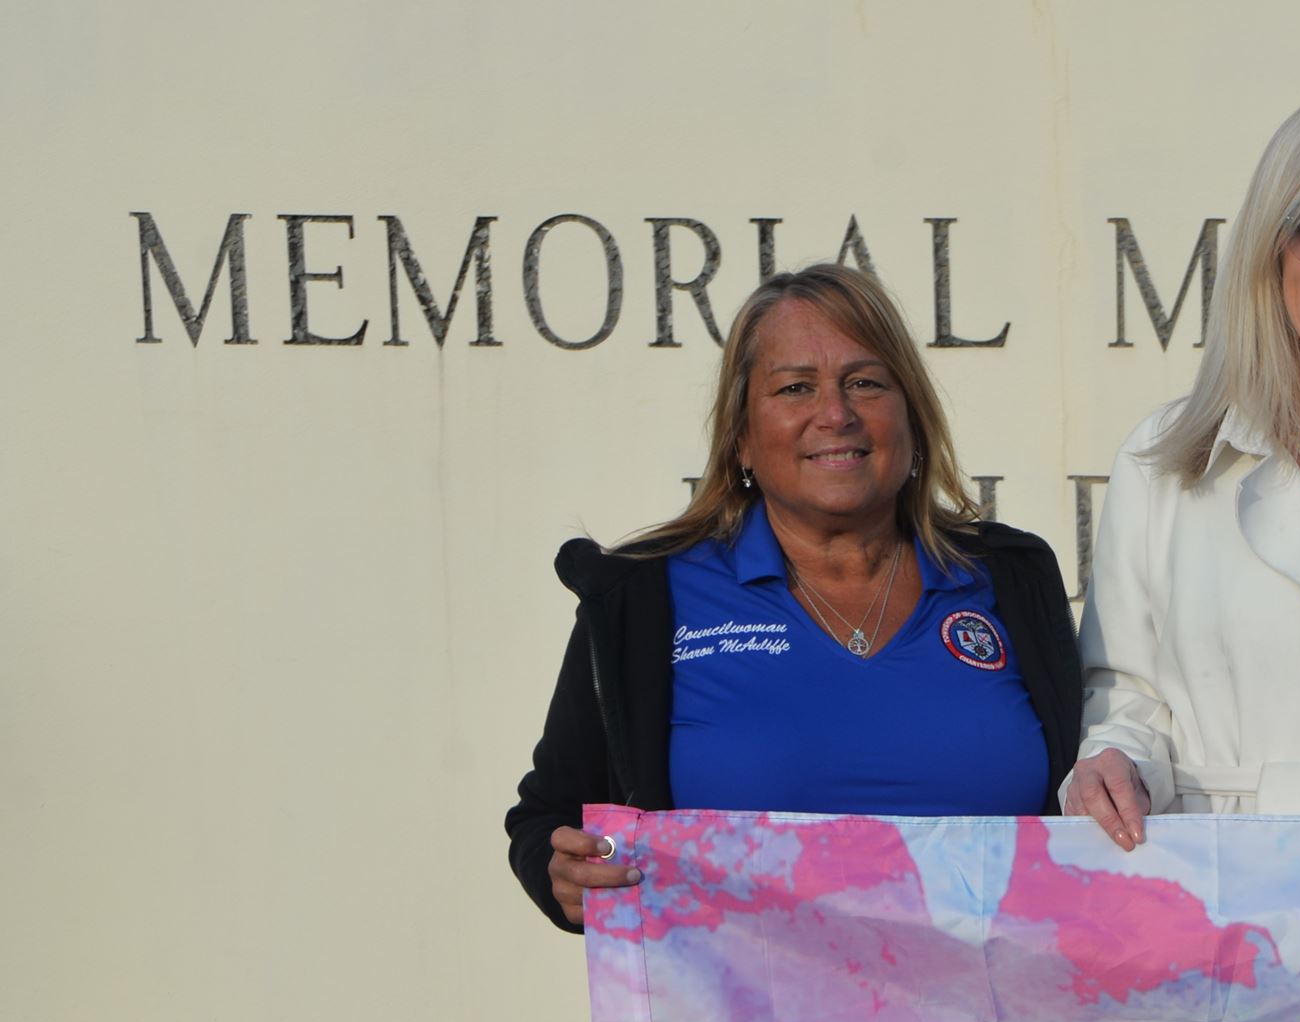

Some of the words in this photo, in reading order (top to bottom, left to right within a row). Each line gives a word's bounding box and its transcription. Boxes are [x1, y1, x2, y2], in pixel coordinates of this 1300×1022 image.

[673, 620, 787, 645] Councilwoman
[671, 645, 715, 664] Sharon
[718, 636, 791, 655] McAuliffe
